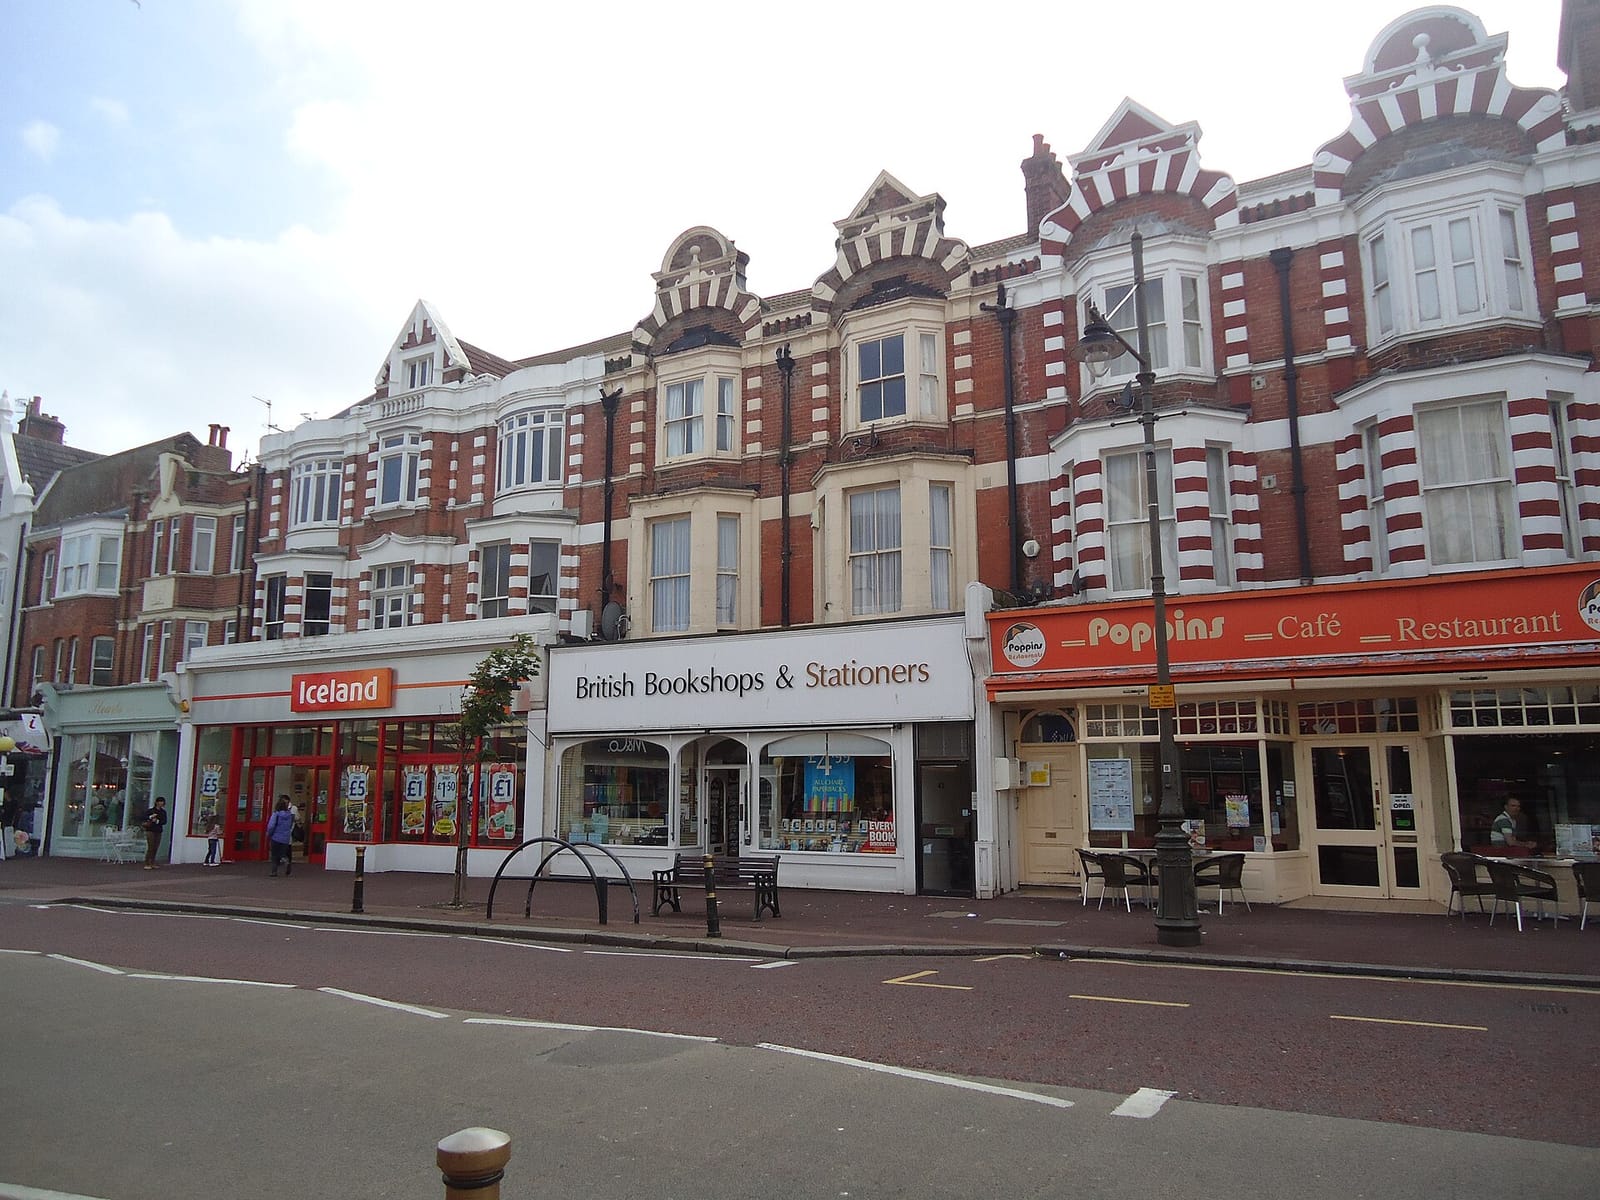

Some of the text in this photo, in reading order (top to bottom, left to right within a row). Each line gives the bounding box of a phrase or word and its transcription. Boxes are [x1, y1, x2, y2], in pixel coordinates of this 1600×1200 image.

[1277, 612, 1341, 640] Café
[1396, 610, 1562, 642] Restaurant
[1008, 641, 1043, 652] Poppins
[576, 659, 930, 699] British Bookshops & Stationers
[299, 676, 378, 704] Iceland
[204, 777, 217, 792] £5
[350, 780, 365, 796] £5
[407, 780, 422, 797] £1
[494, 779, 511, 797] £1
[869, 831, 895, 842] BOOK
